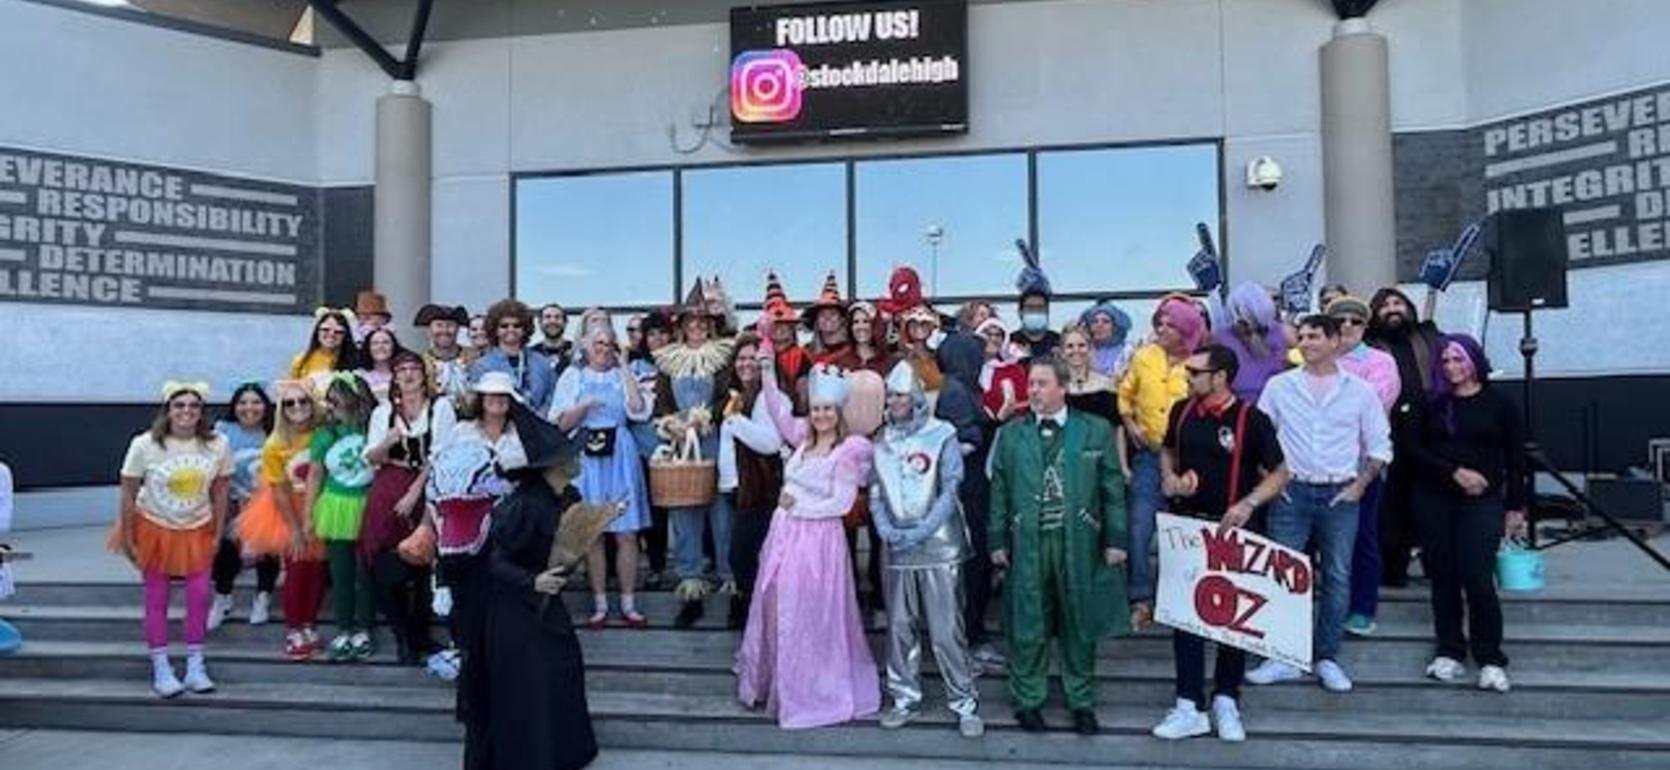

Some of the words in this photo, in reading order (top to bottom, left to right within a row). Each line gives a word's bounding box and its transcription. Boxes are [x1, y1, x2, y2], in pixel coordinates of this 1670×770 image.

[776, 13, 871, 46] FOLLOW
[875, 10, 919, 39] US!
[796, 56, 958, 90] @stockdalehigh
[37, 188, 302, 237] RESPONSIBILITY
[1568, 221, 1670, 260] ELLE
[39, 244, 295, 285] DETERMINATION
[1161, 528, 1200, 549] The
[1194, 575, 1269, 639] OZ
